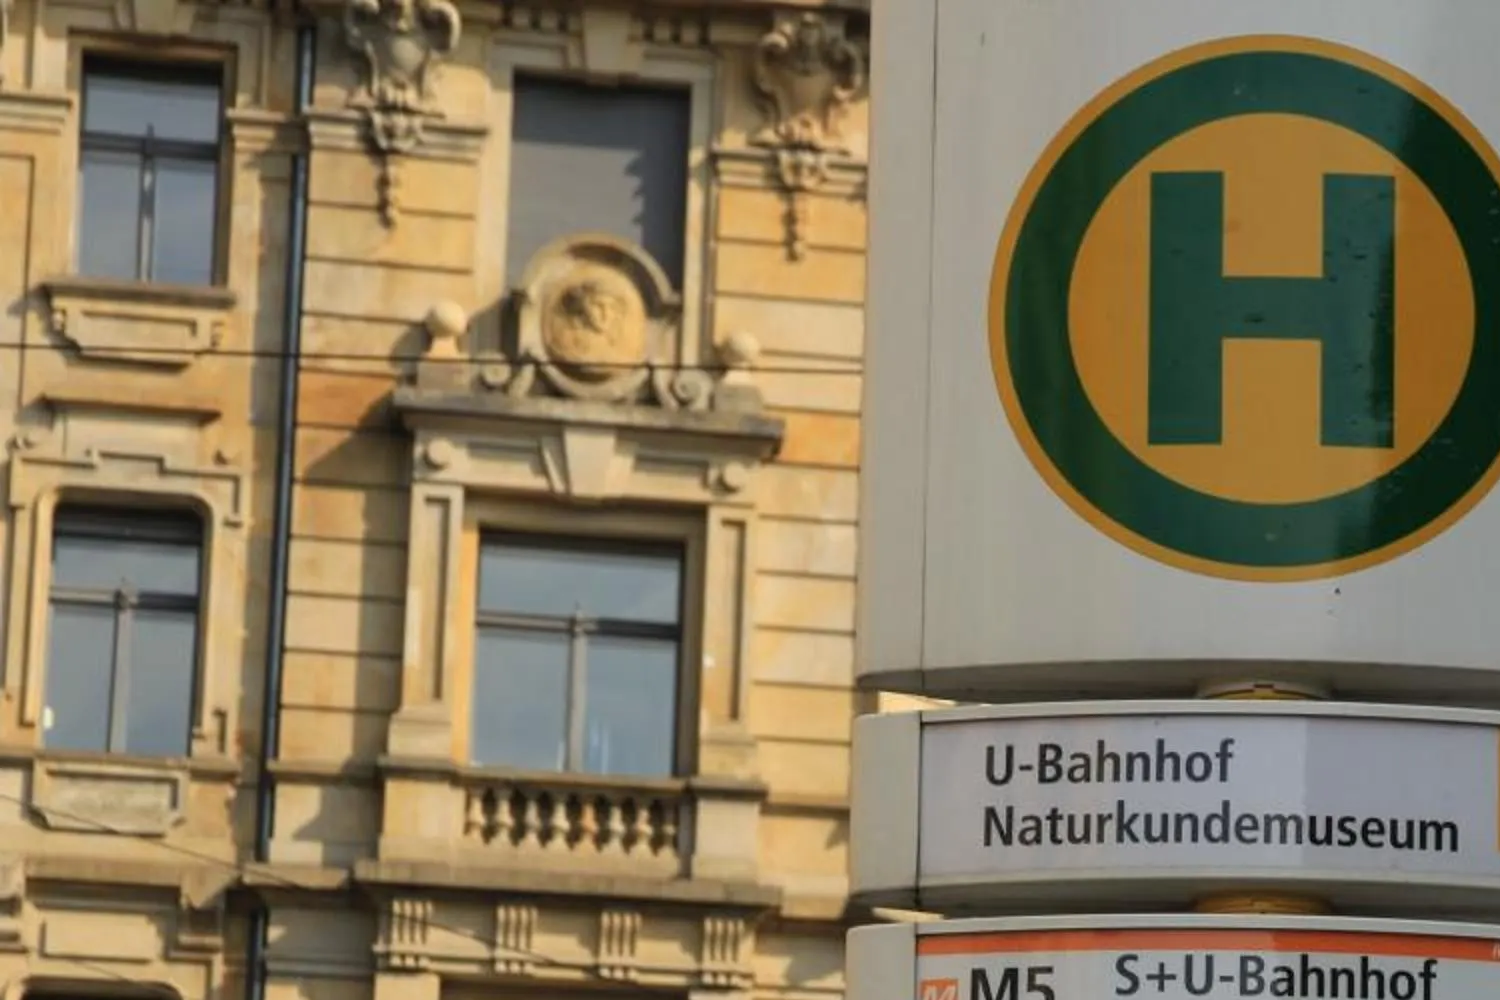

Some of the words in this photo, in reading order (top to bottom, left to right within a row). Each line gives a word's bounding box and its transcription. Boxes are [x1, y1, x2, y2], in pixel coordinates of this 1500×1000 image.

[1147, 170, 1396, 448] H
[984, 737, 1235, 787] U-Bahnhof
[982, 798, 1460, 854] Naturkundemuseum
